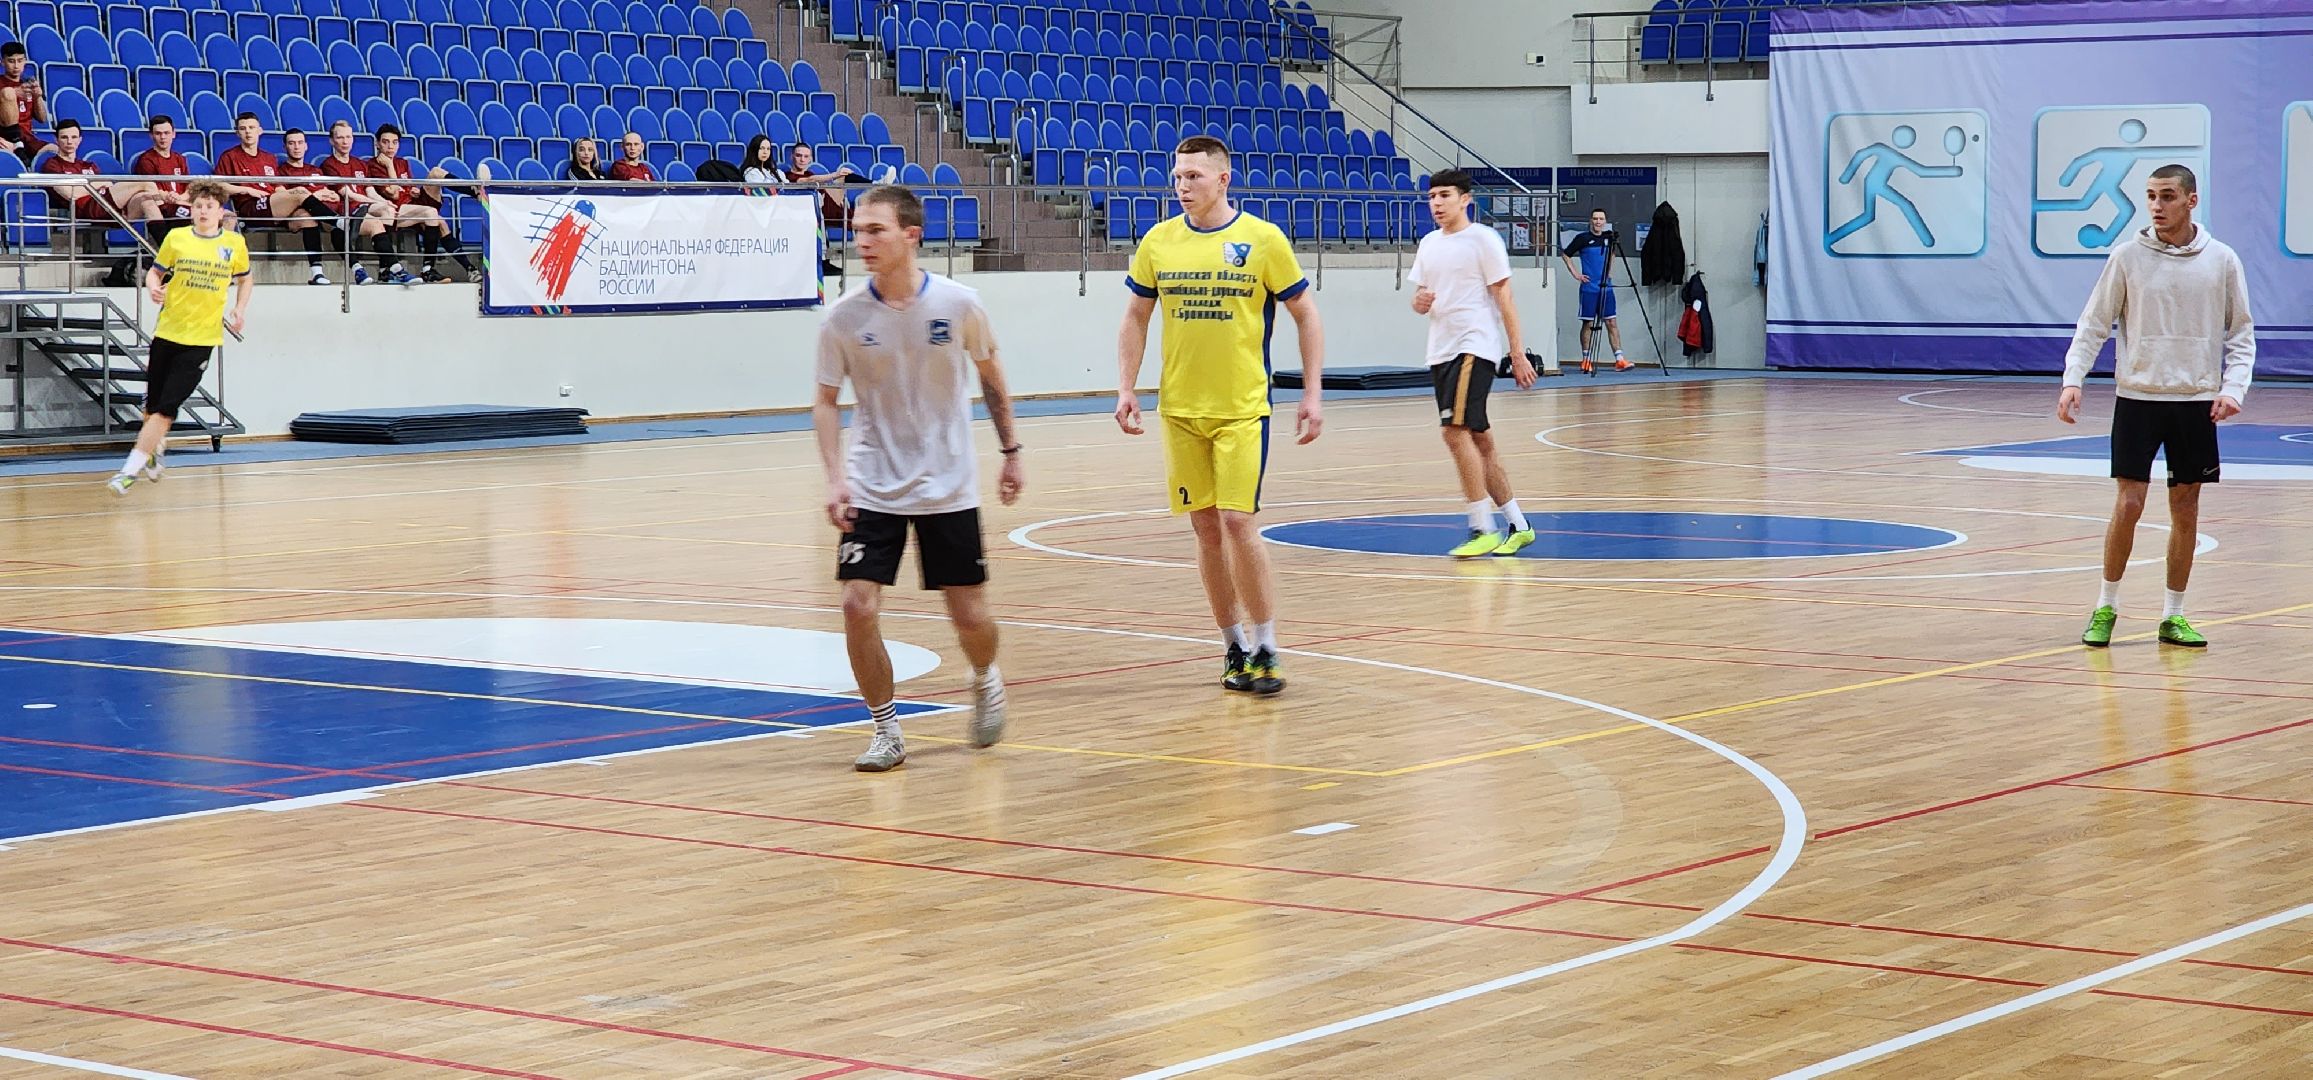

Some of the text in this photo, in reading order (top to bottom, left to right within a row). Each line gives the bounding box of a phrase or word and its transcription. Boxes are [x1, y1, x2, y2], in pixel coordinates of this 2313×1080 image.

[1569, 169, 1644, 178] ИНФОРМАЦИЯ
[600, 237, 789, 258] НАЦИОНАЛЬНАЯ ФЕДЕРАЦИЯ
[599, 258, 696, 278] БАДМИНТОНА
[599, 278, 655, 295] РОССИИ
[1178, 486, 1192, 505] 2
